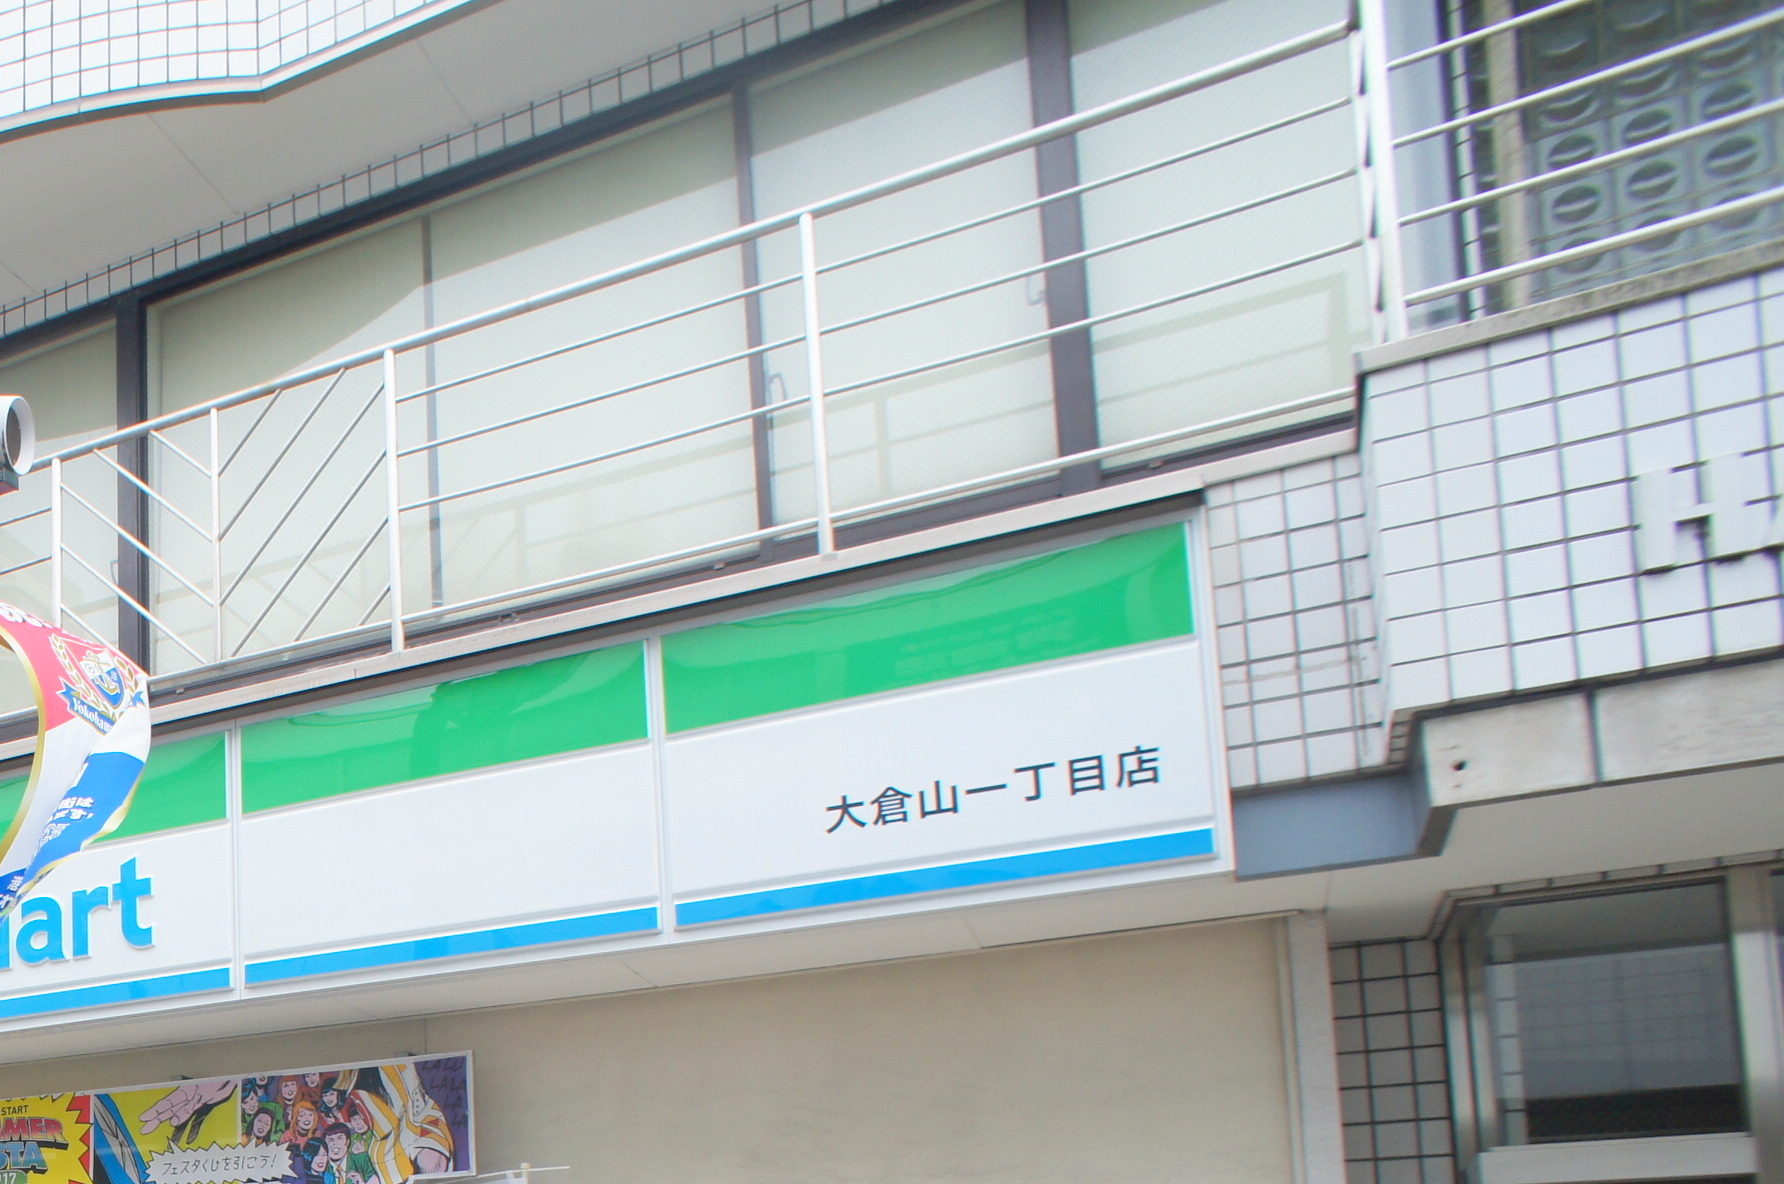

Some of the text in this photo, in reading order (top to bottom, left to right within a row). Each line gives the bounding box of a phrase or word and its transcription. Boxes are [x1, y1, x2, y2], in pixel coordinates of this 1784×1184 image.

[72, 697, 114, 733] Yokoham
[825, 744, 1160, 834] 大倉山一丁目店
[1, 1105, 29, 1116] START
